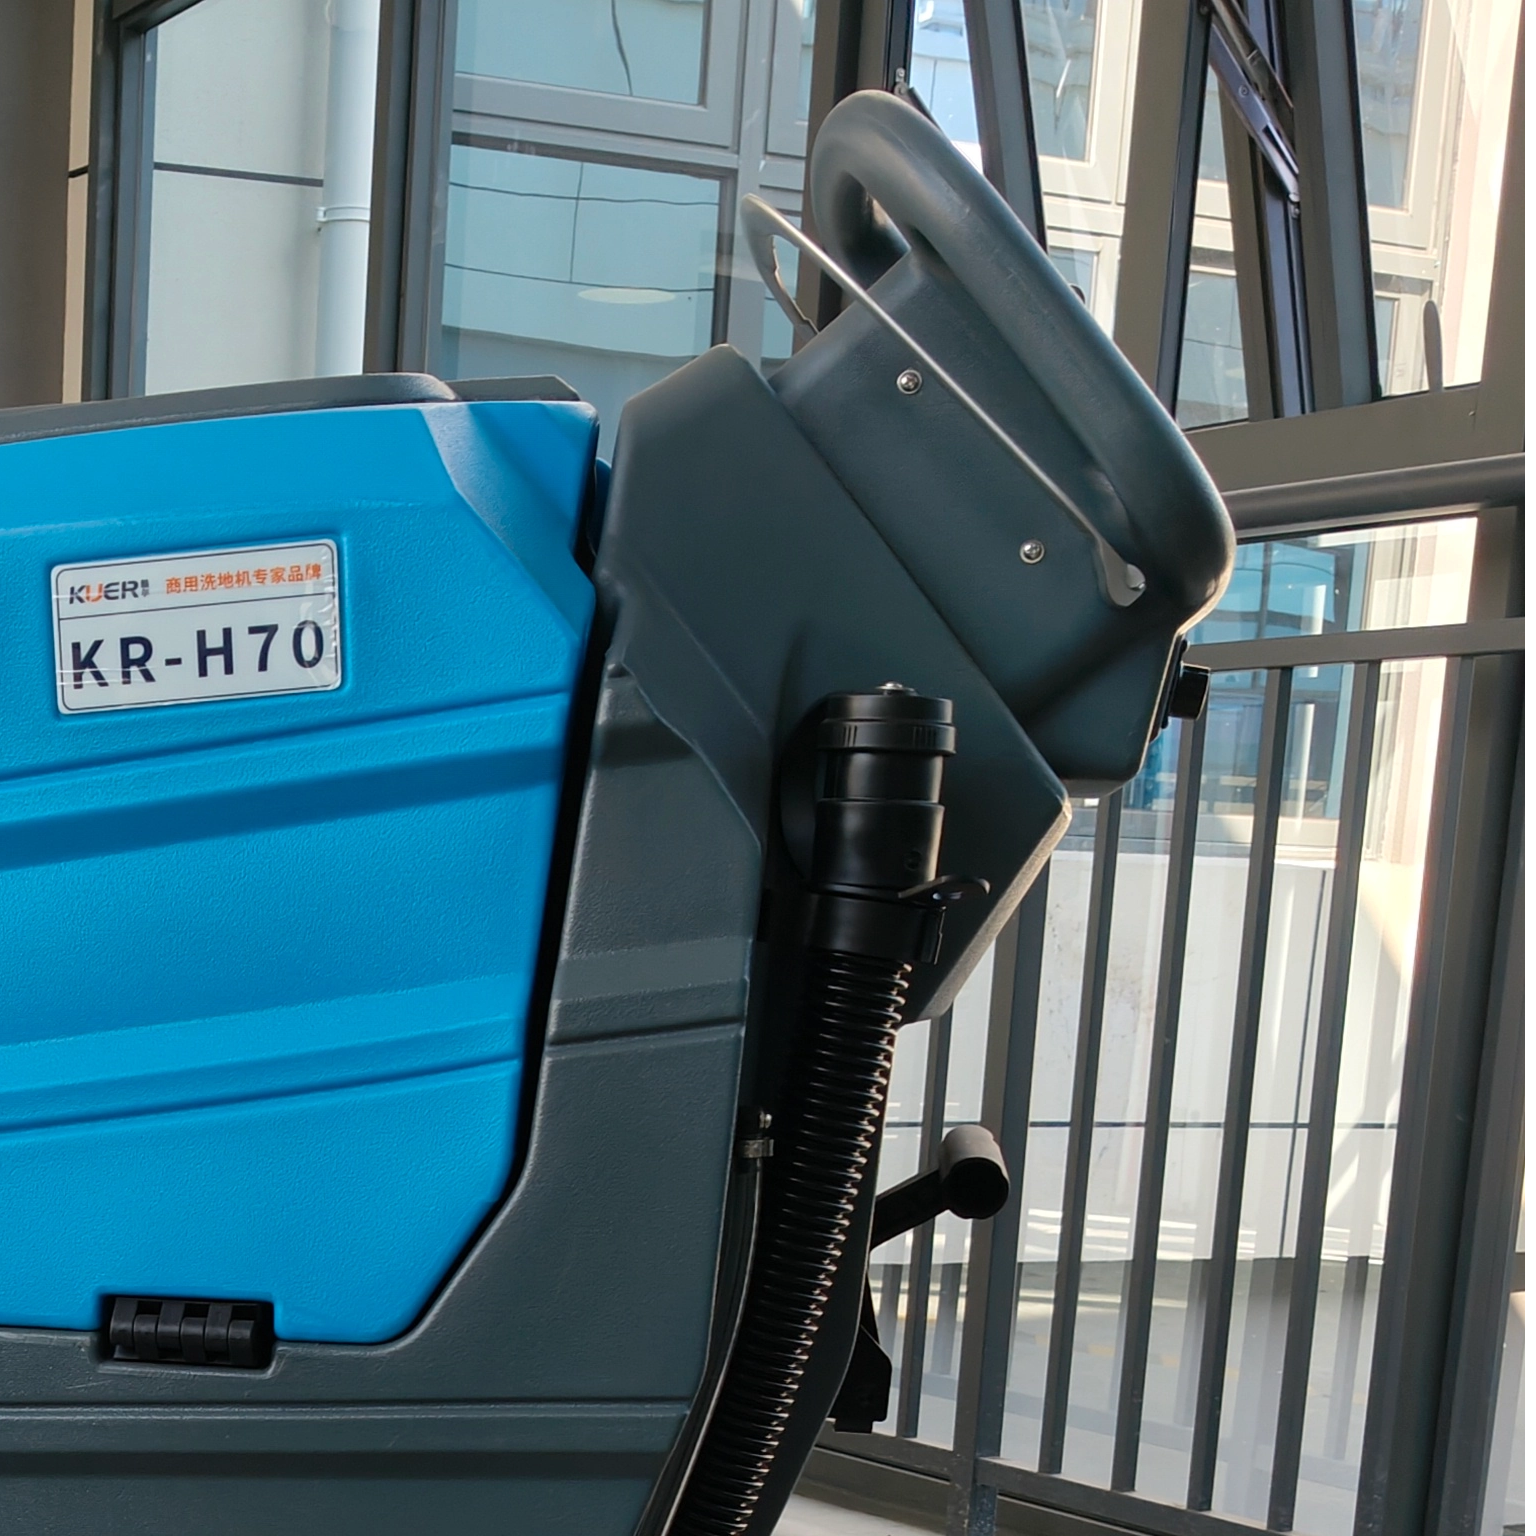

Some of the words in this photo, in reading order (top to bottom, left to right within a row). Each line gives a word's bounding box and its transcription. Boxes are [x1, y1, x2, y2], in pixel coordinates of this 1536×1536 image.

[69, 580, 139, 604] KUER
[165, 563, 322, 594] 商用洗地机专家品牌
[71, 619, 325, 690] KR-H70
